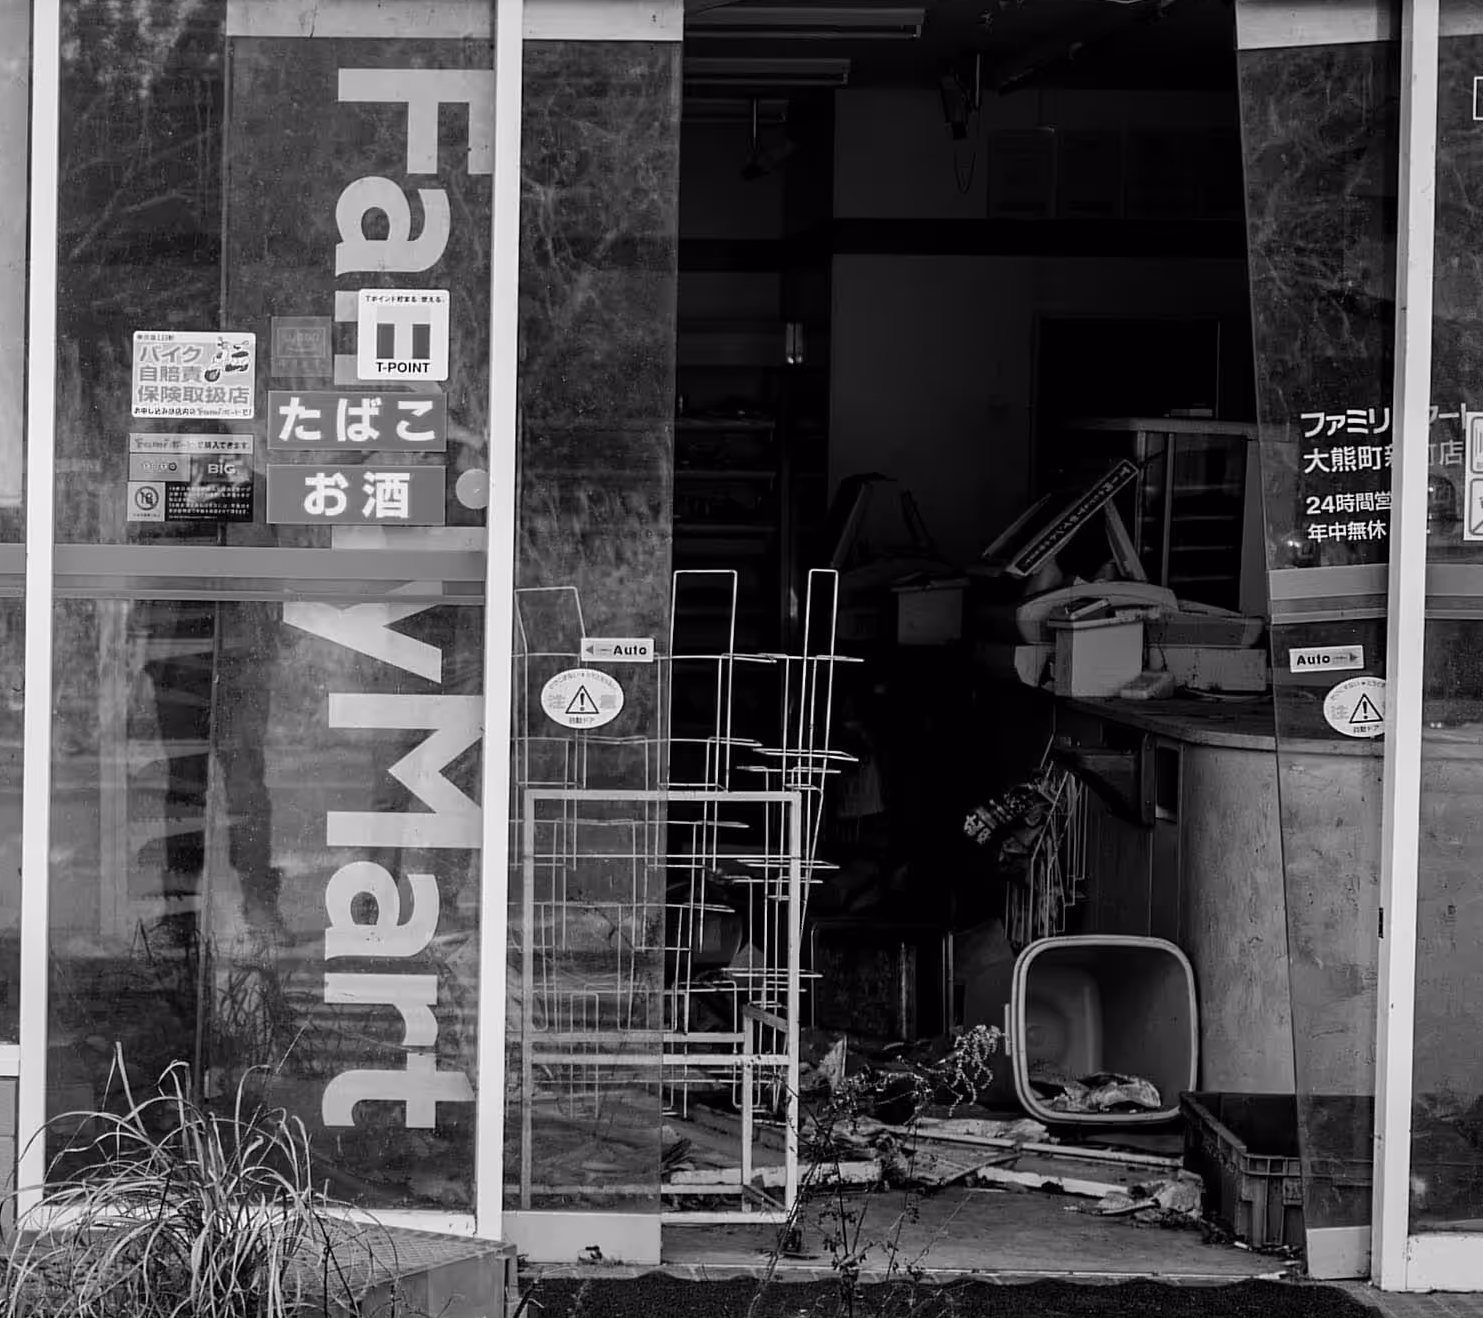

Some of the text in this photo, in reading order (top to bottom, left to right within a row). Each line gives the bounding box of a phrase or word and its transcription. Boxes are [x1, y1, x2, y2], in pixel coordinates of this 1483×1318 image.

[139, 345, 202, 363] バイク
[139, 365, 202, 383] 自賠責
[376, 362, 431, 373] T-POINT
[137, 385, 250, 404] 保険取扱店
[279, 397, 436, 442] たばこ
[207, 463, 236, 474] BIG
[304, 471, 410, 519] お酒
[1308, 520, 1387, 543] 年中無休
[614, 645, 647, 655] Auto
[1296, 654, 1330, 666] Auto
